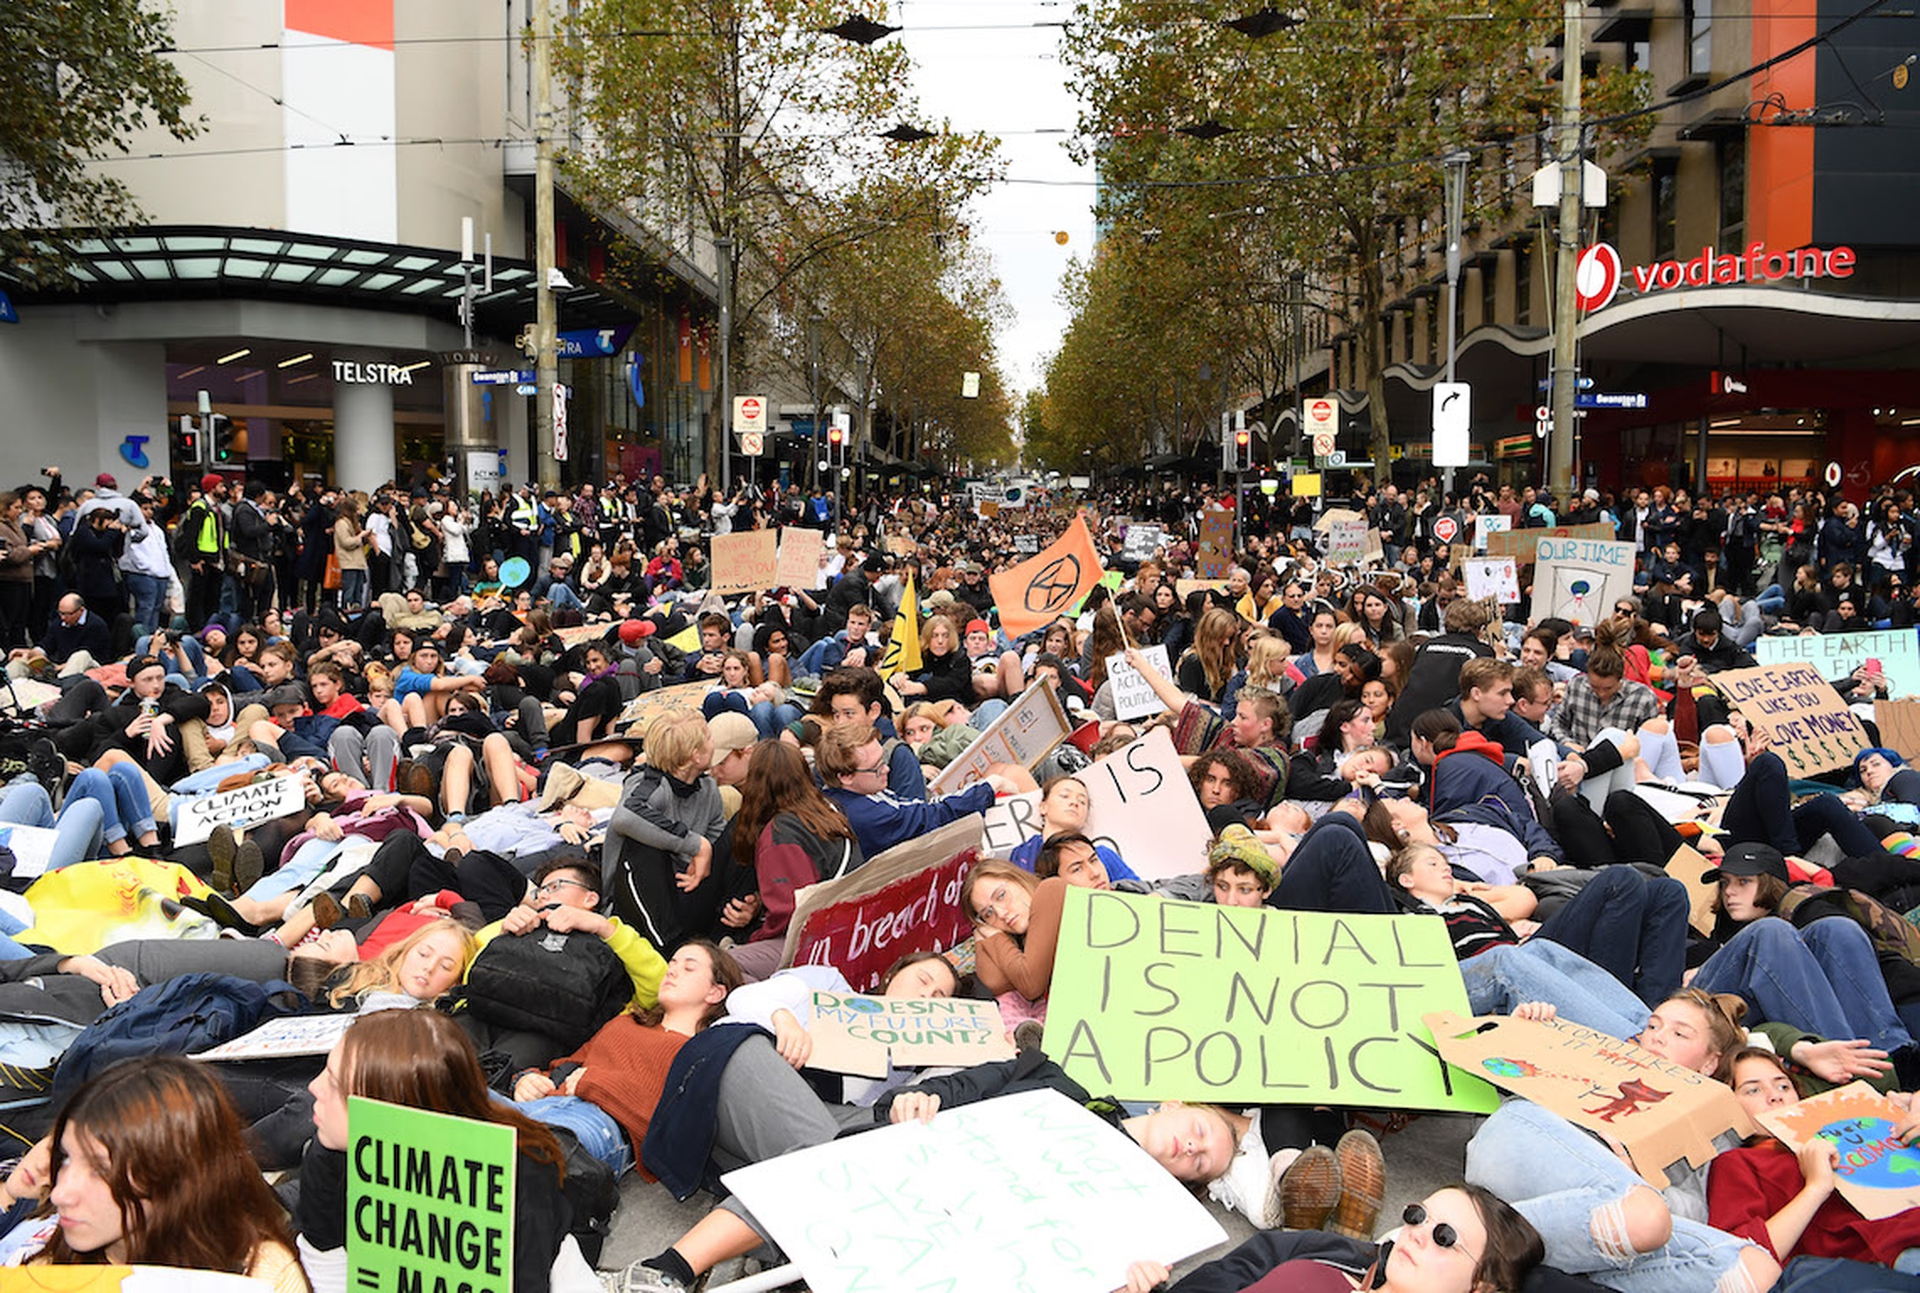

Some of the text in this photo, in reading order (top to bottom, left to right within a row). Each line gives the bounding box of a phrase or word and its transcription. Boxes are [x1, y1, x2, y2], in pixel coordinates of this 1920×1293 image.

[1632, 241, 1857, 293] vodafone
[332, 361, 412, 385] TELSTRA
[1501, 530, 1550, 556] TIM
[1538, 540, 1630, 567] OUR TIME
[1760, 632, 1908, 658] THE EARTH
[1719, 668, 1826, 704] LOVE EARTH
[1756, 692, 1821, 715] LIKE YOU
[1761, 710, 1861, 747] LOVE MONEY
[1105, 743, 1164, 804] IS
[191, 779, 288, 814] CLIMATE
[198, 796, 282, 827] ACTION
[847, 872, 939, 962] breach
[942, 861, 969, 907] of
[1086, 892, 1446, 968] DENIAL
[1100, 955, 1426, 1033] IS NOT
[817, 1005, 991, 1031] MY FUTURE
[848, 1025, 993, 1046] COUNT?
[1061, 1018, 1455, 1097] A POLICY
[1541, 1017, 1702, 1086] SCOMO LIKES
[355, 1135, 504, 1214] CLIMATE
[354, 1195, 503, 1277] CHANGE
